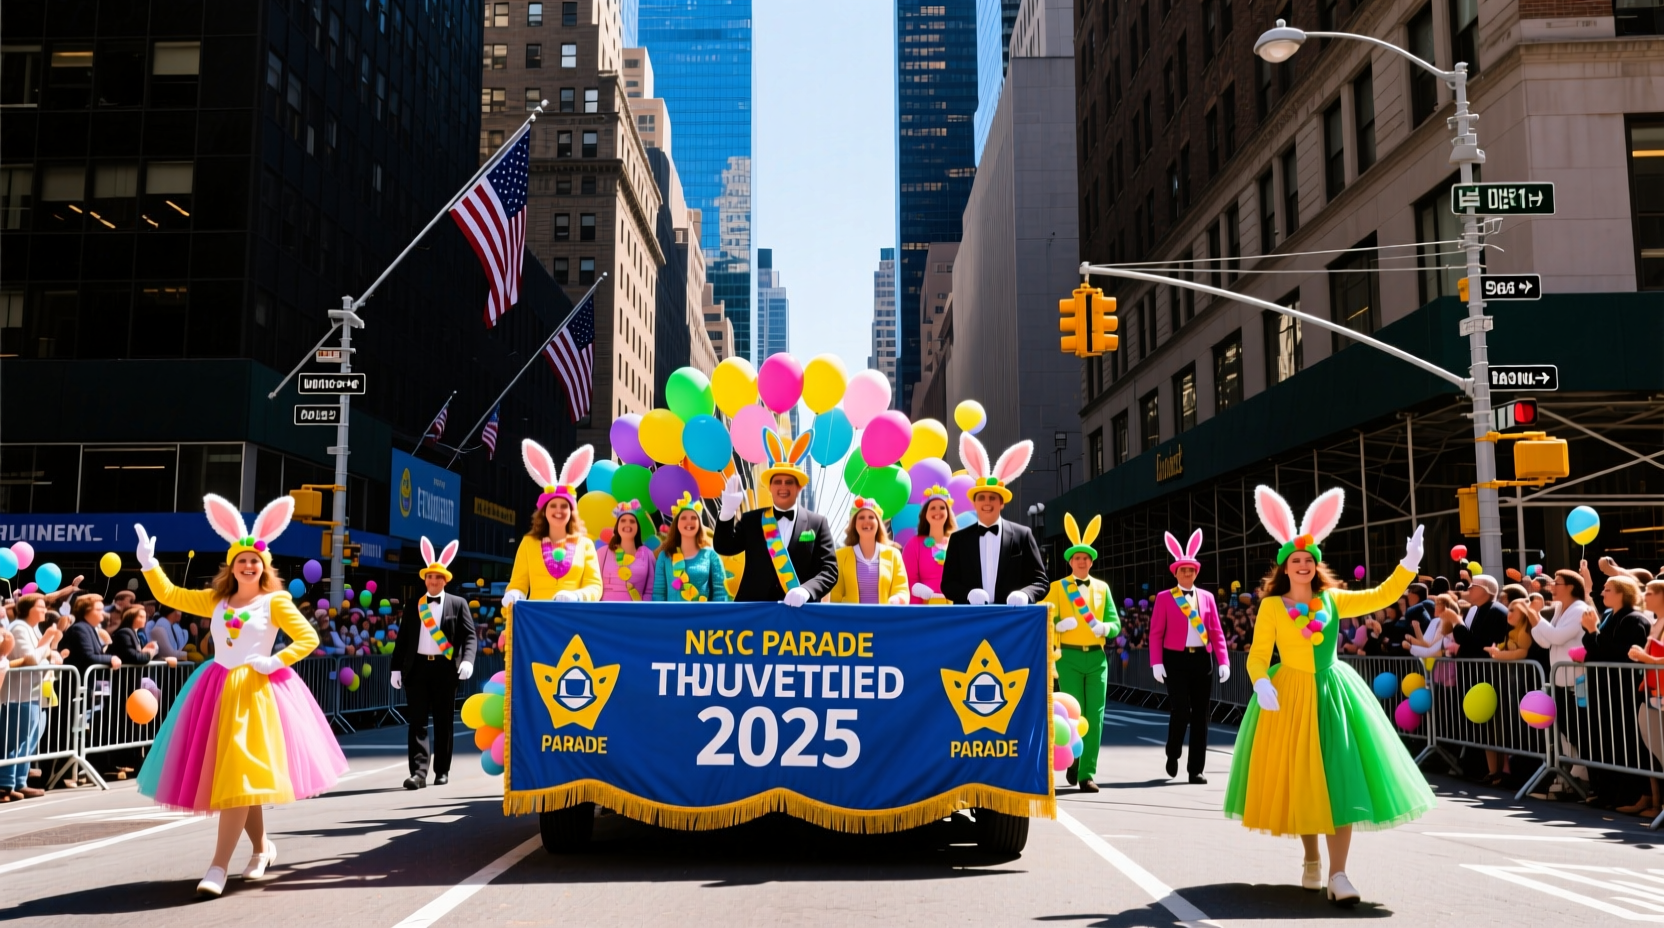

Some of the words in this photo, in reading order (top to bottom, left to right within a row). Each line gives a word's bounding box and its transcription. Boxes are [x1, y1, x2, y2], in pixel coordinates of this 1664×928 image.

[762, 630, 874, 658] PARADE
[541, 734, 608, 754] PARADE
[696, 705, 862, 769] 2025
[950, 739, 1019, 758] PARADE
